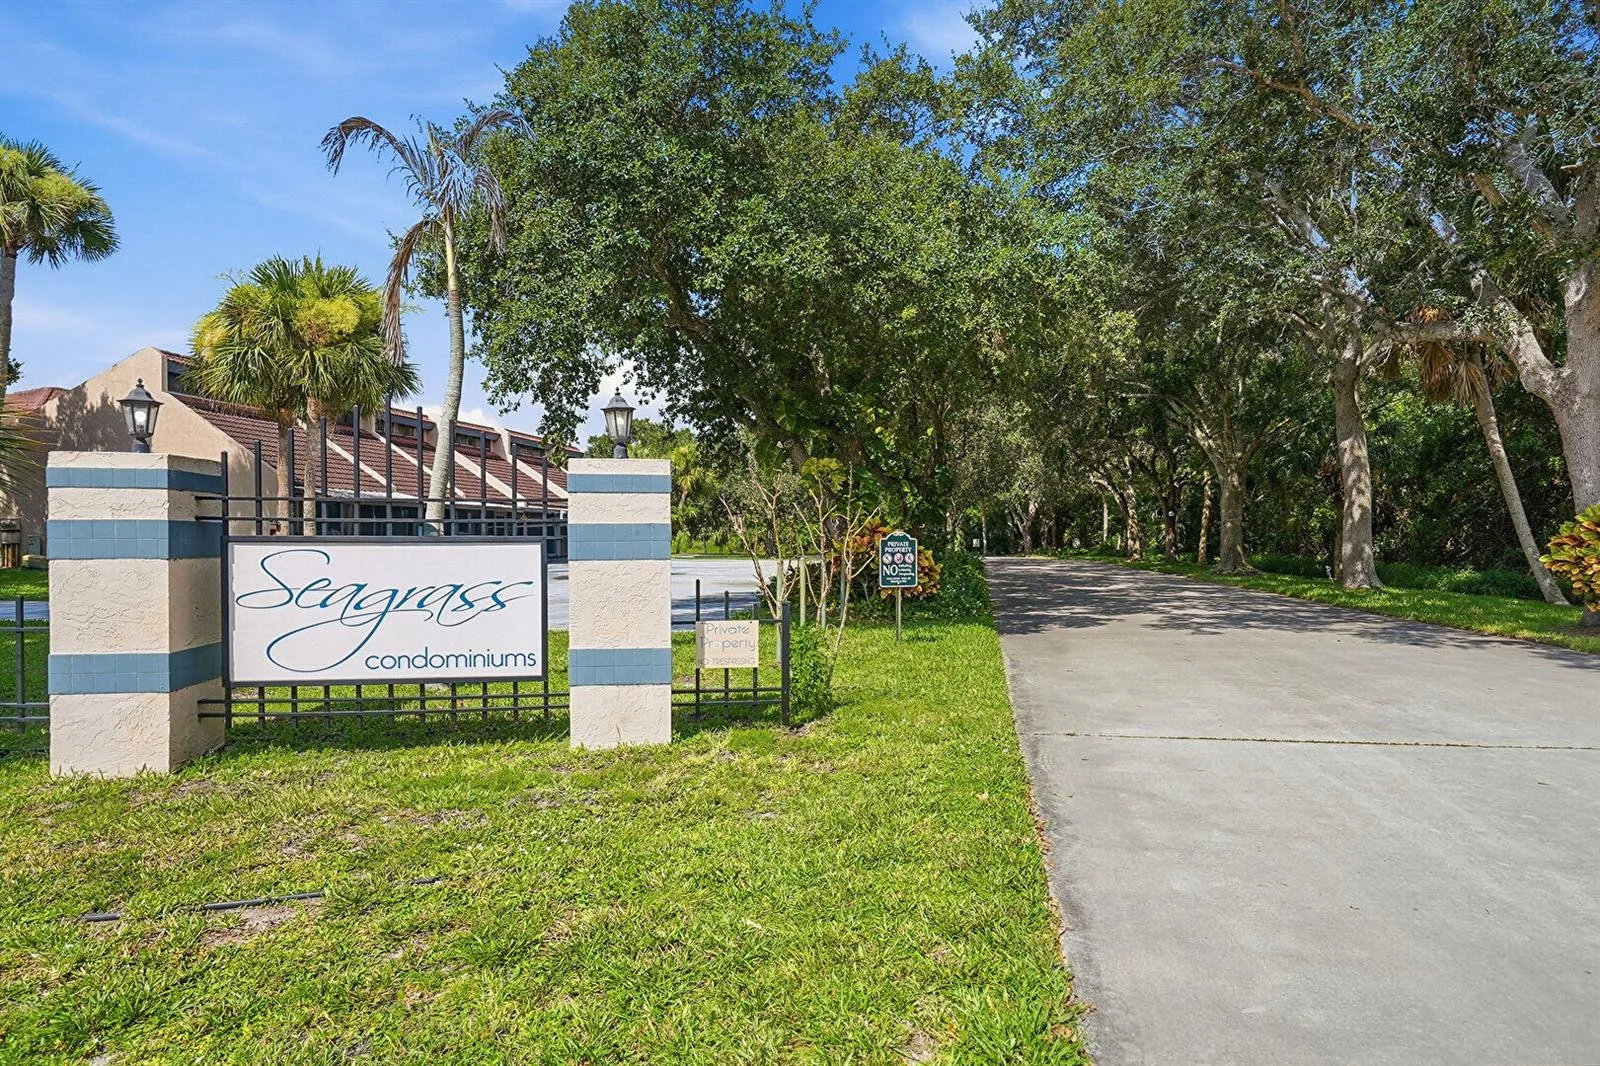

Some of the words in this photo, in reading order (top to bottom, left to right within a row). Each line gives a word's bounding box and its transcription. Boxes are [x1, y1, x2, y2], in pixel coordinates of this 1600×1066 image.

[882, 564, 898, 576] NO
[235, 549, 534, 672] Seagrass
[706, 622, 750, 635] Private
[700, 636, 756, 652] Prperty
[364, 646, 537, 670] condominiums
